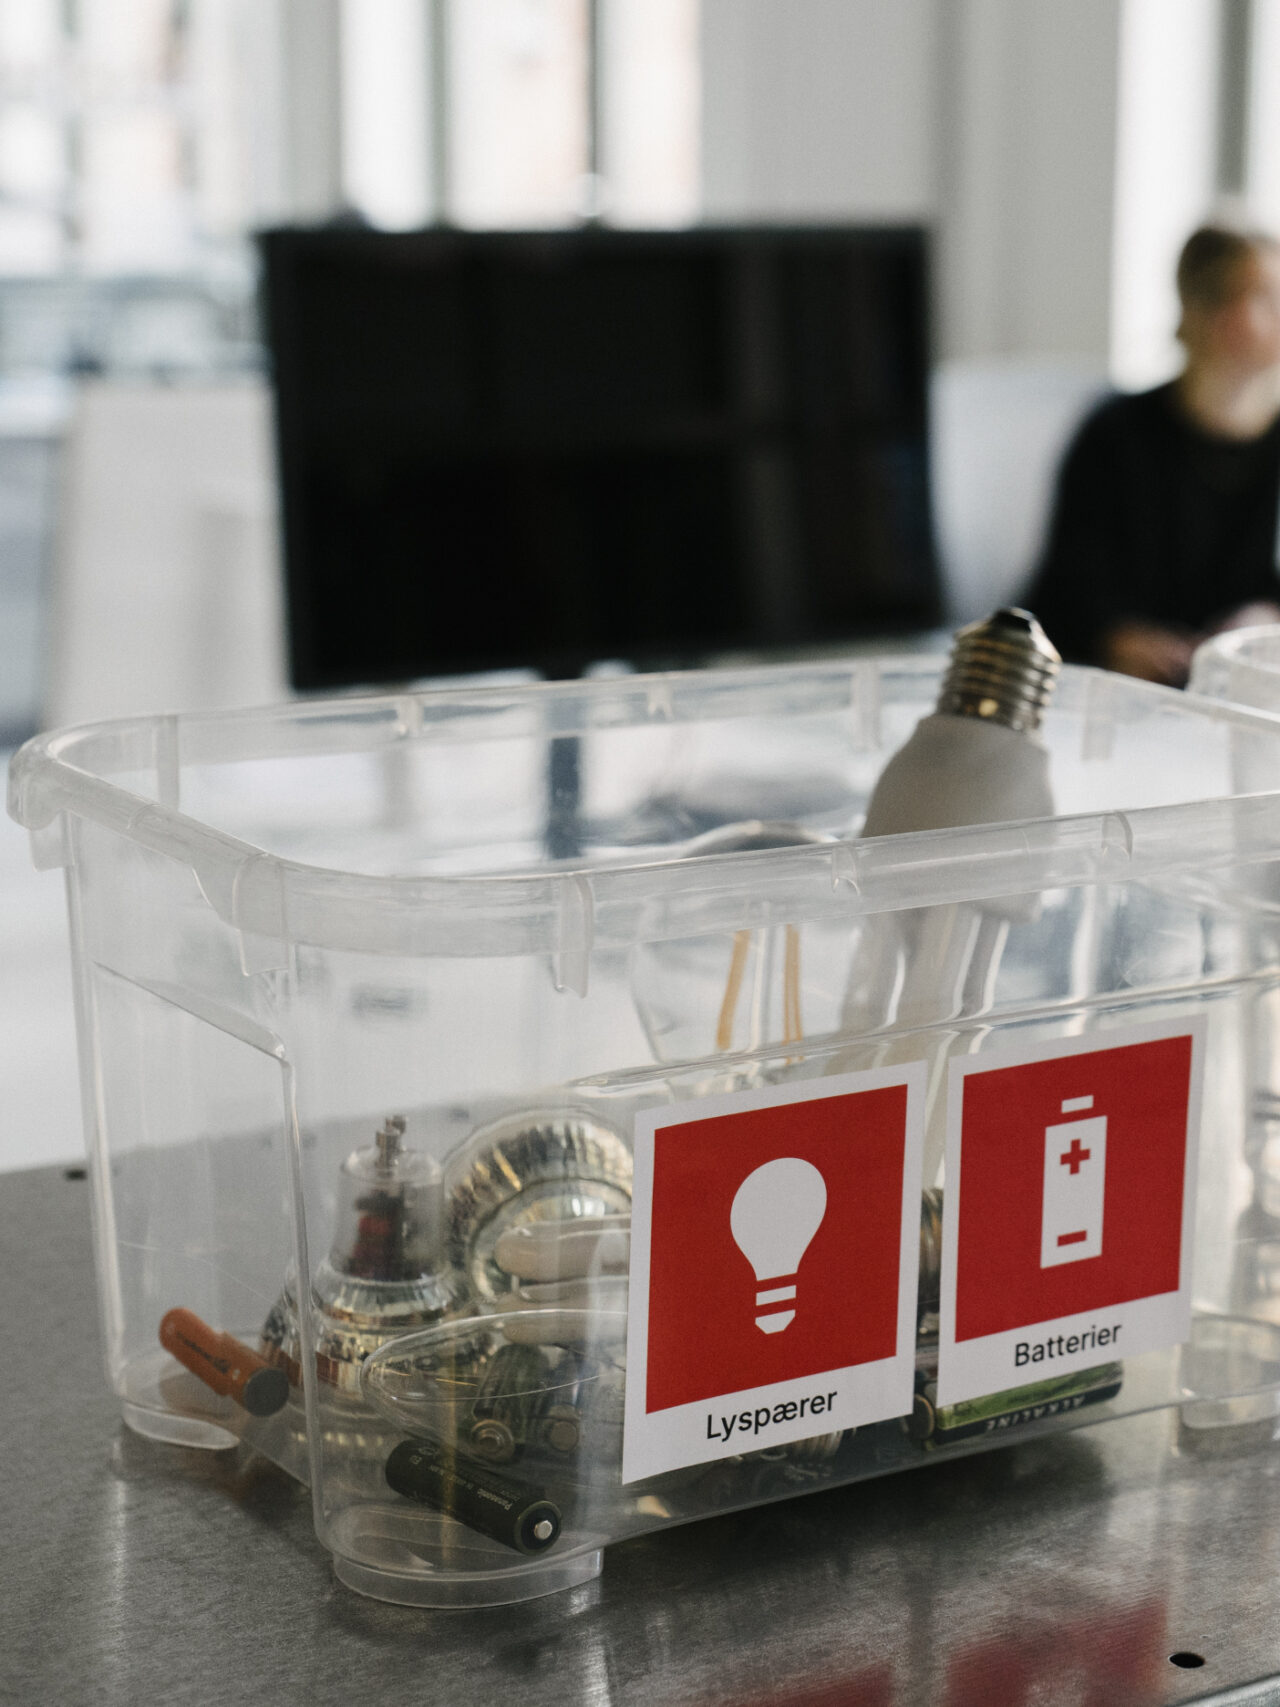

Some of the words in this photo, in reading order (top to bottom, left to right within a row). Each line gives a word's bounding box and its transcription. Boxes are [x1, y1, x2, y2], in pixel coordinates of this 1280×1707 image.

[1014, 1325, 1122, 1367] Batterier
[706, 1391, 838, 1442] Lyspærer
[986, 1395, 1086, 1431] ALKALINE
